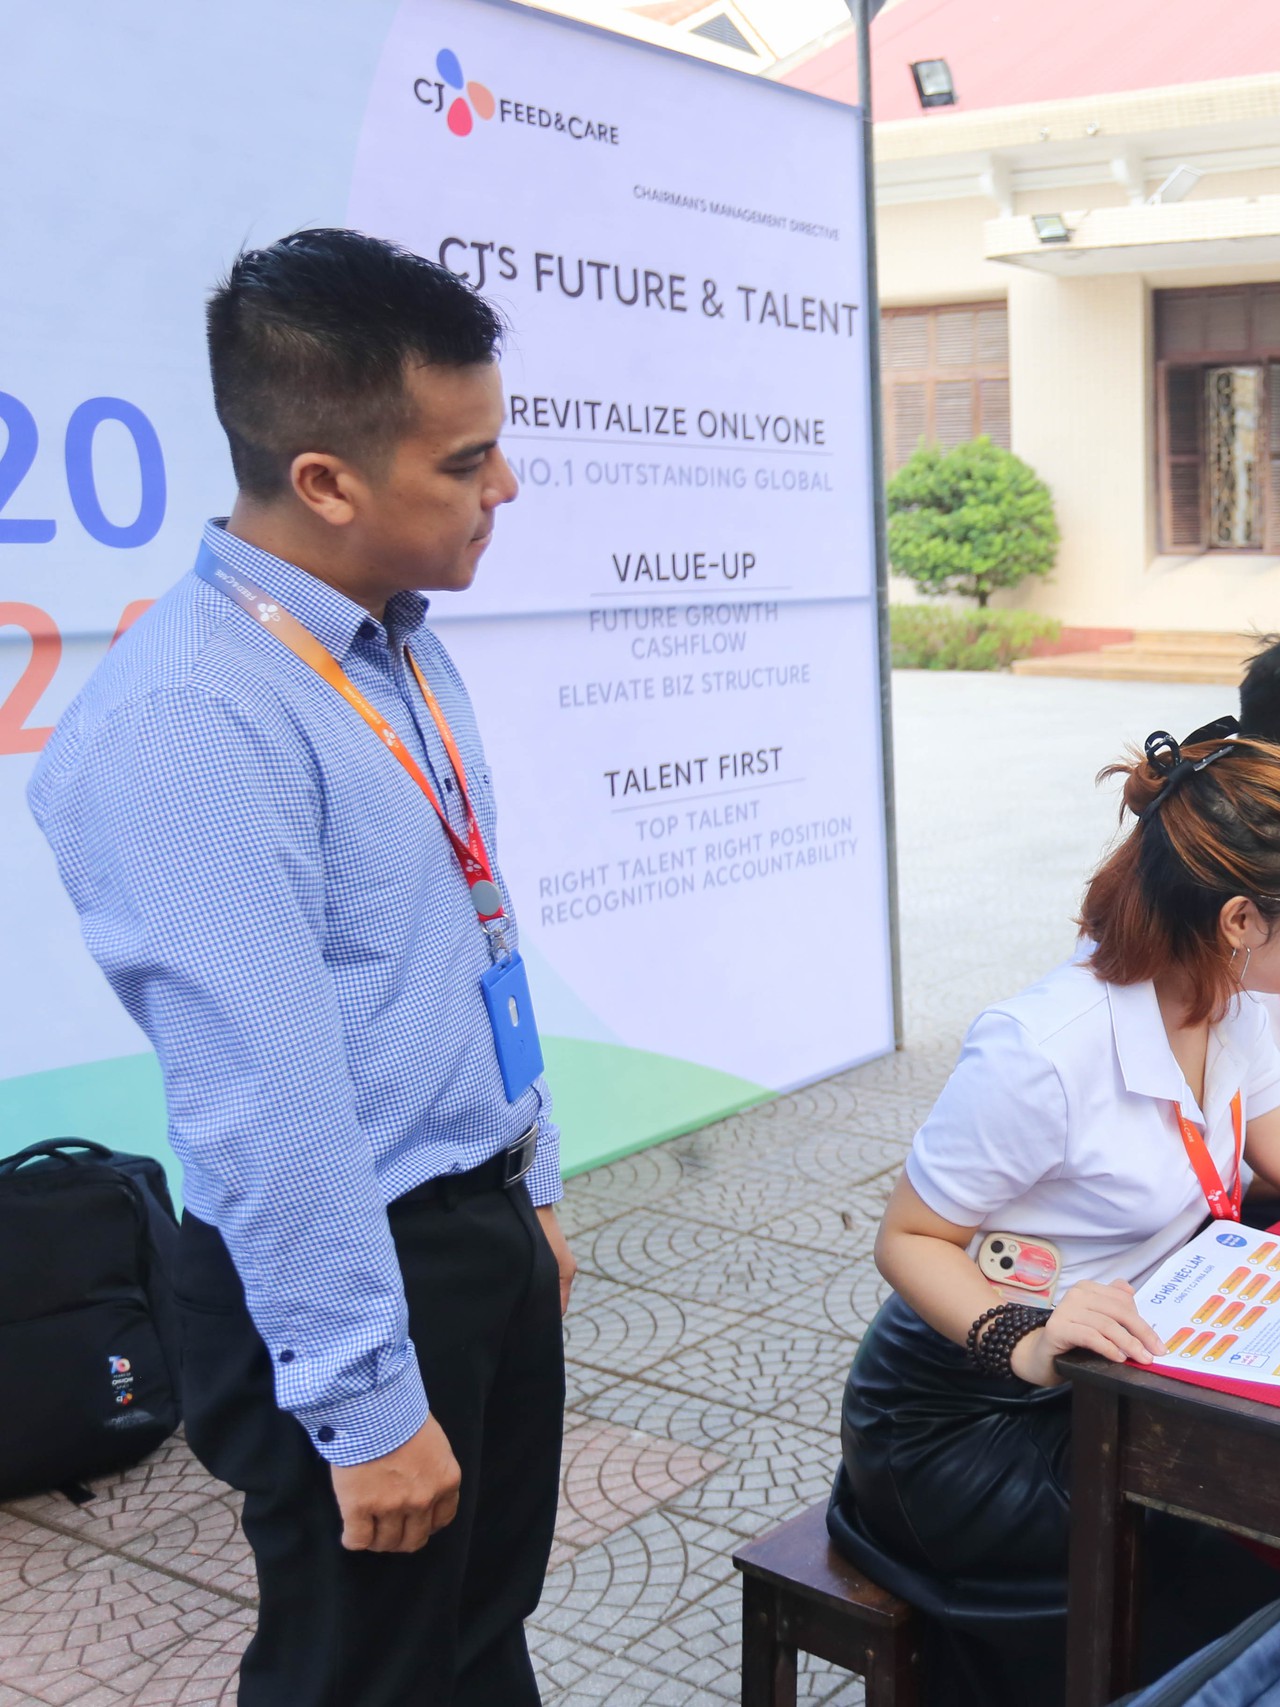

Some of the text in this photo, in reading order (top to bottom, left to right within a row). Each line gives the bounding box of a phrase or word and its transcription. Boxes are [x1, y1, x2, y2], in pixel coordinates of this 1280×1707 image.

[413, 78, 620, 145] CJ FEED&CARE
[709, 200, 787, 229] MANAGEMENT
[789, 218, 840, 242] DIRECTIVE
[534, 251, 687, 312] FUTURE
[700, 278, 726, 320] &
[736, 285, 860, 338] TALENT
[510, 394, 827, 446] REVITALIZE ONLYONE
[585, 461, 747, 491] OUTSTANDING
[754, 467, 834, 493] GLOBAL
[611, 551, 757, 584] VALUE-UP
[589, 602, 780, 633] FUTURE GROWTH
[630, 631, 747, 661] CASHFLOW
[558, 663, 811, 709] ELEVATE BIZ STRUCTURE
[603, 747, 783, 798] TALENT FIRST
[635, 800, 761, 842] TOP TALENT
[538, 816, 853, 899] RIGHT TALENT RIGHT POSITION
[540, 837, 858, 928] RECOGNITION ACCOUNTABILITY
